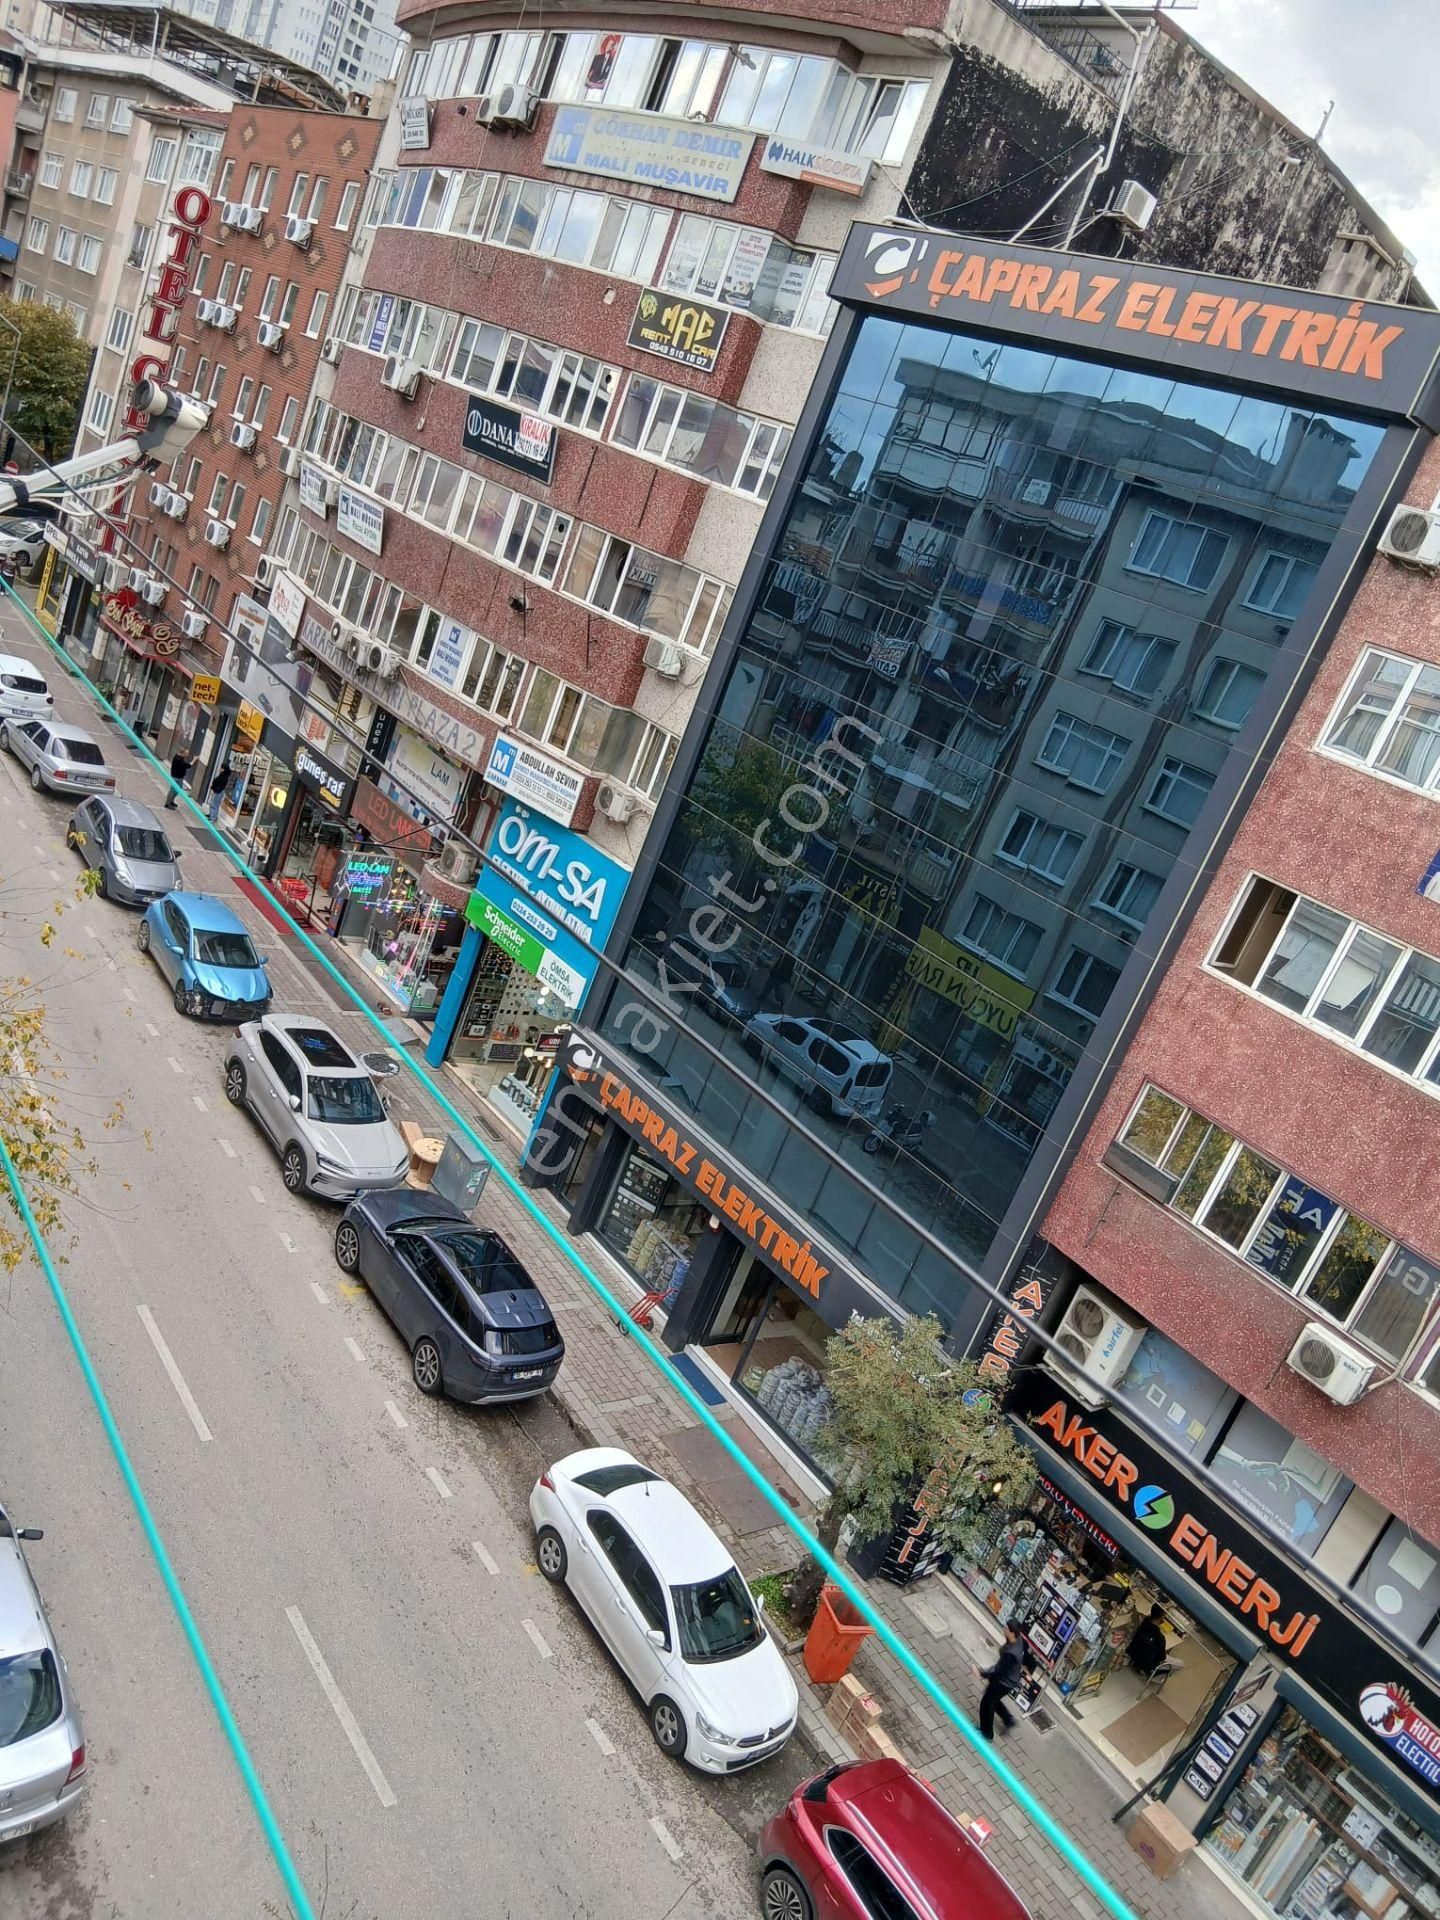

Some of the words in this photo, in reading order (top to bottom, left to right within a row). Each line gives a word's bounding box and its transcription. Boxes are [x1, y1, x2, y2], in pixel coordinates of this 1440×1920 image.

[671, 129, 743, 160] DEMİR
[584, 152, 629, 172] MALİ
[634, 161, 730, 194] MÜŞAVİR
[143, 186, 212, 346] OTEL
[927, 250, 1121, 324] ÇAPRAZ
[1114, 281, 1404, 381] ELEKTRİK
[640, 327, 671, 344] RENT
[691, 344, 716, 359] CAR
[192, 690, 215, 702] tech
[461, 733, 477, 754] 2
[430, 761, 450, 787] LAM
[520, 751, 556, 780] ABDULLAH
[327, 775, 347, 797] raf
[484, 905, 526, 947] Schneider
[540, 967, 574, 1001] ELEKTRİK
[550, 960, 571, 984] ÖMSA
[600, 1071, 699, 1176] ÇAPRAZ
[695, 1158, 831, 1301] ELEKTRİK
[1106, 1321, 1126, 1353] airfel
[1038, 1400, 1140, 1502] AKER
[1168, 1512, 1321, 1658] ENERJİ
